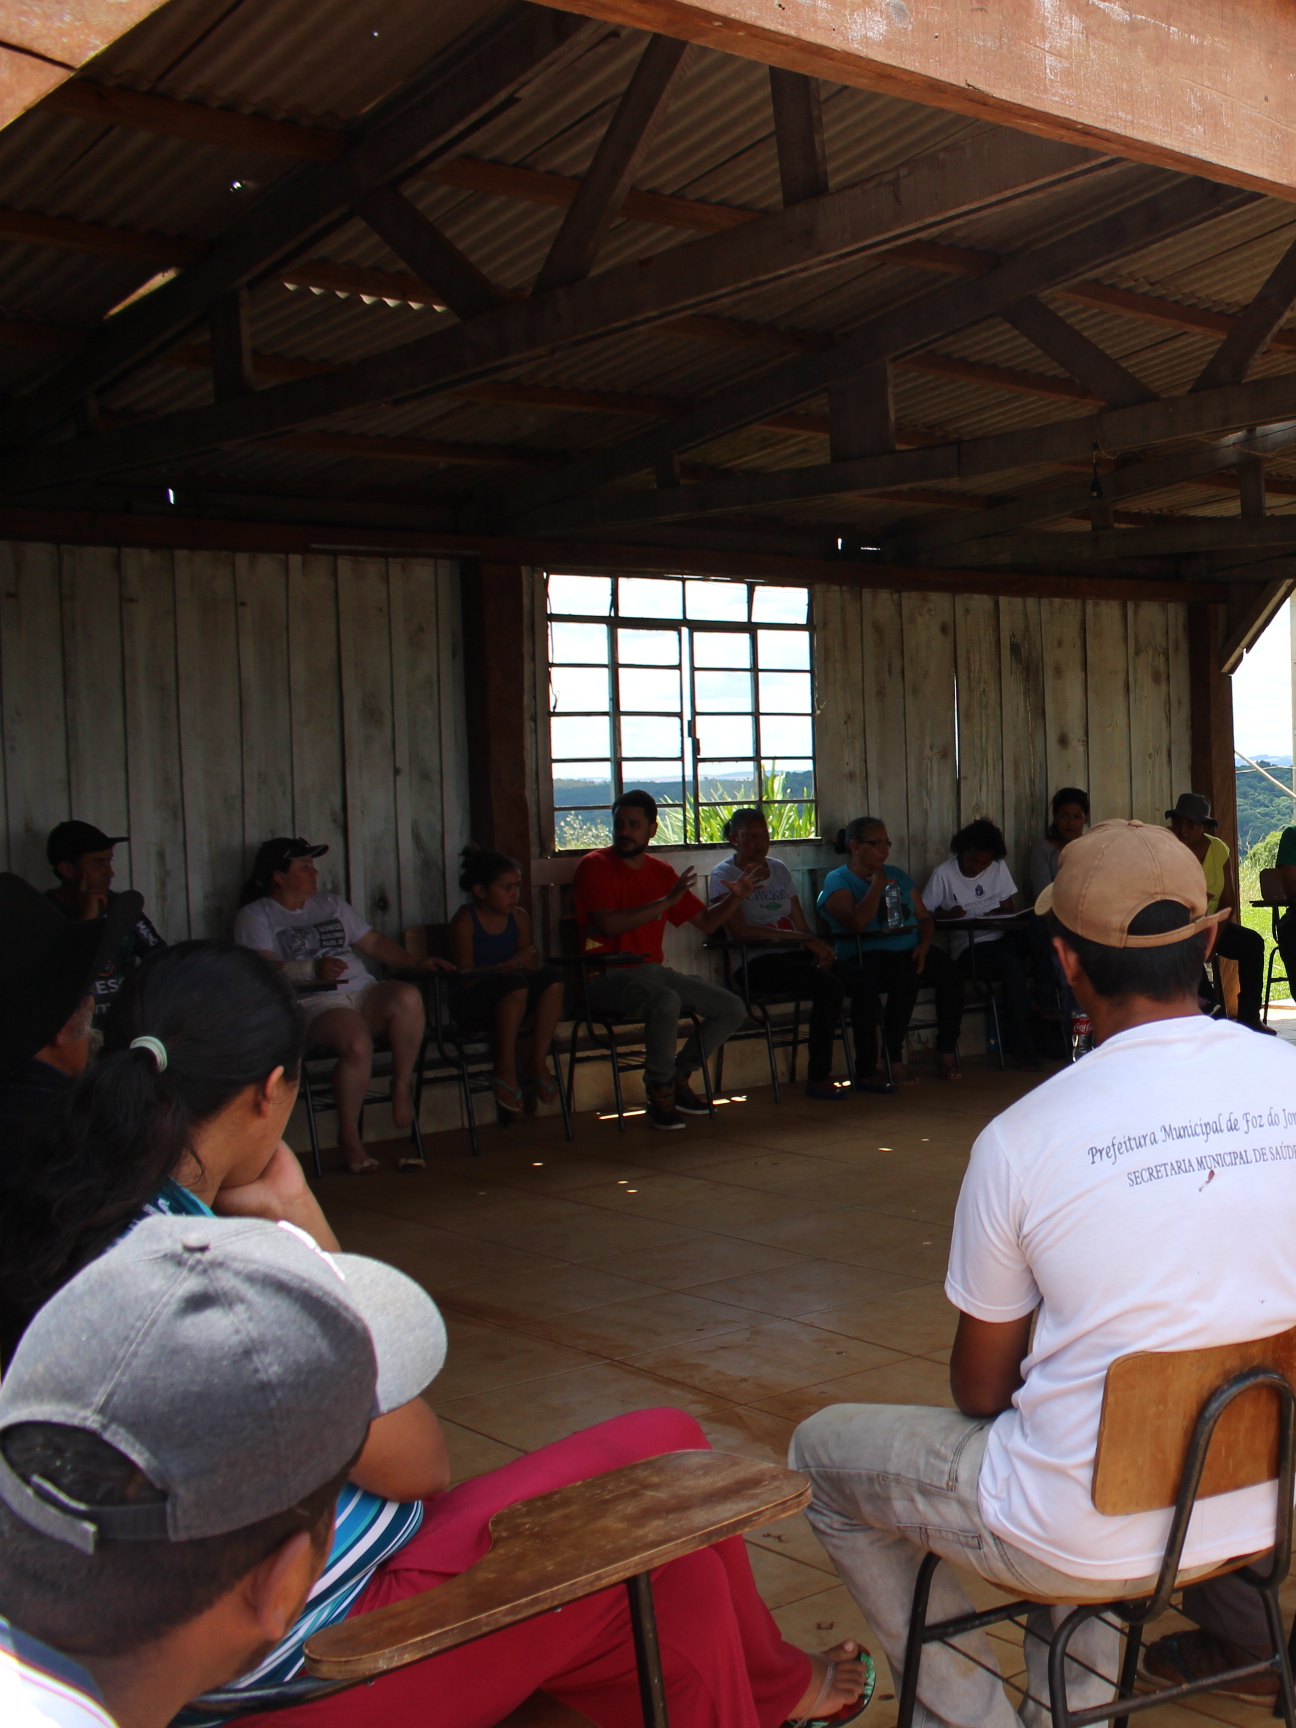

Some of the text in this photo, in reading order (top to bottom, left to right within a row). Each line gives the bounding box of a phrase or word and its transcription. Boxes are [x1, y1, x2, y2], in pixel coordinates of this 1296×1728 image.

[1087, 1130, 1158, 1165] Prefeitura
[1160, 1112, 1224, 1143] Municipal
[1226, 1111, 1240, 1132] de
[1243, 1111, 1264, 1135] Foz
[1266, 1106, 1280, 1127] do
[1126, 1158, 1195, 1187] SECRETARIA
[1196, 1149, 1253, 1171] MUNICIPAL
[1253, 1146, 1268, 1163] DE
